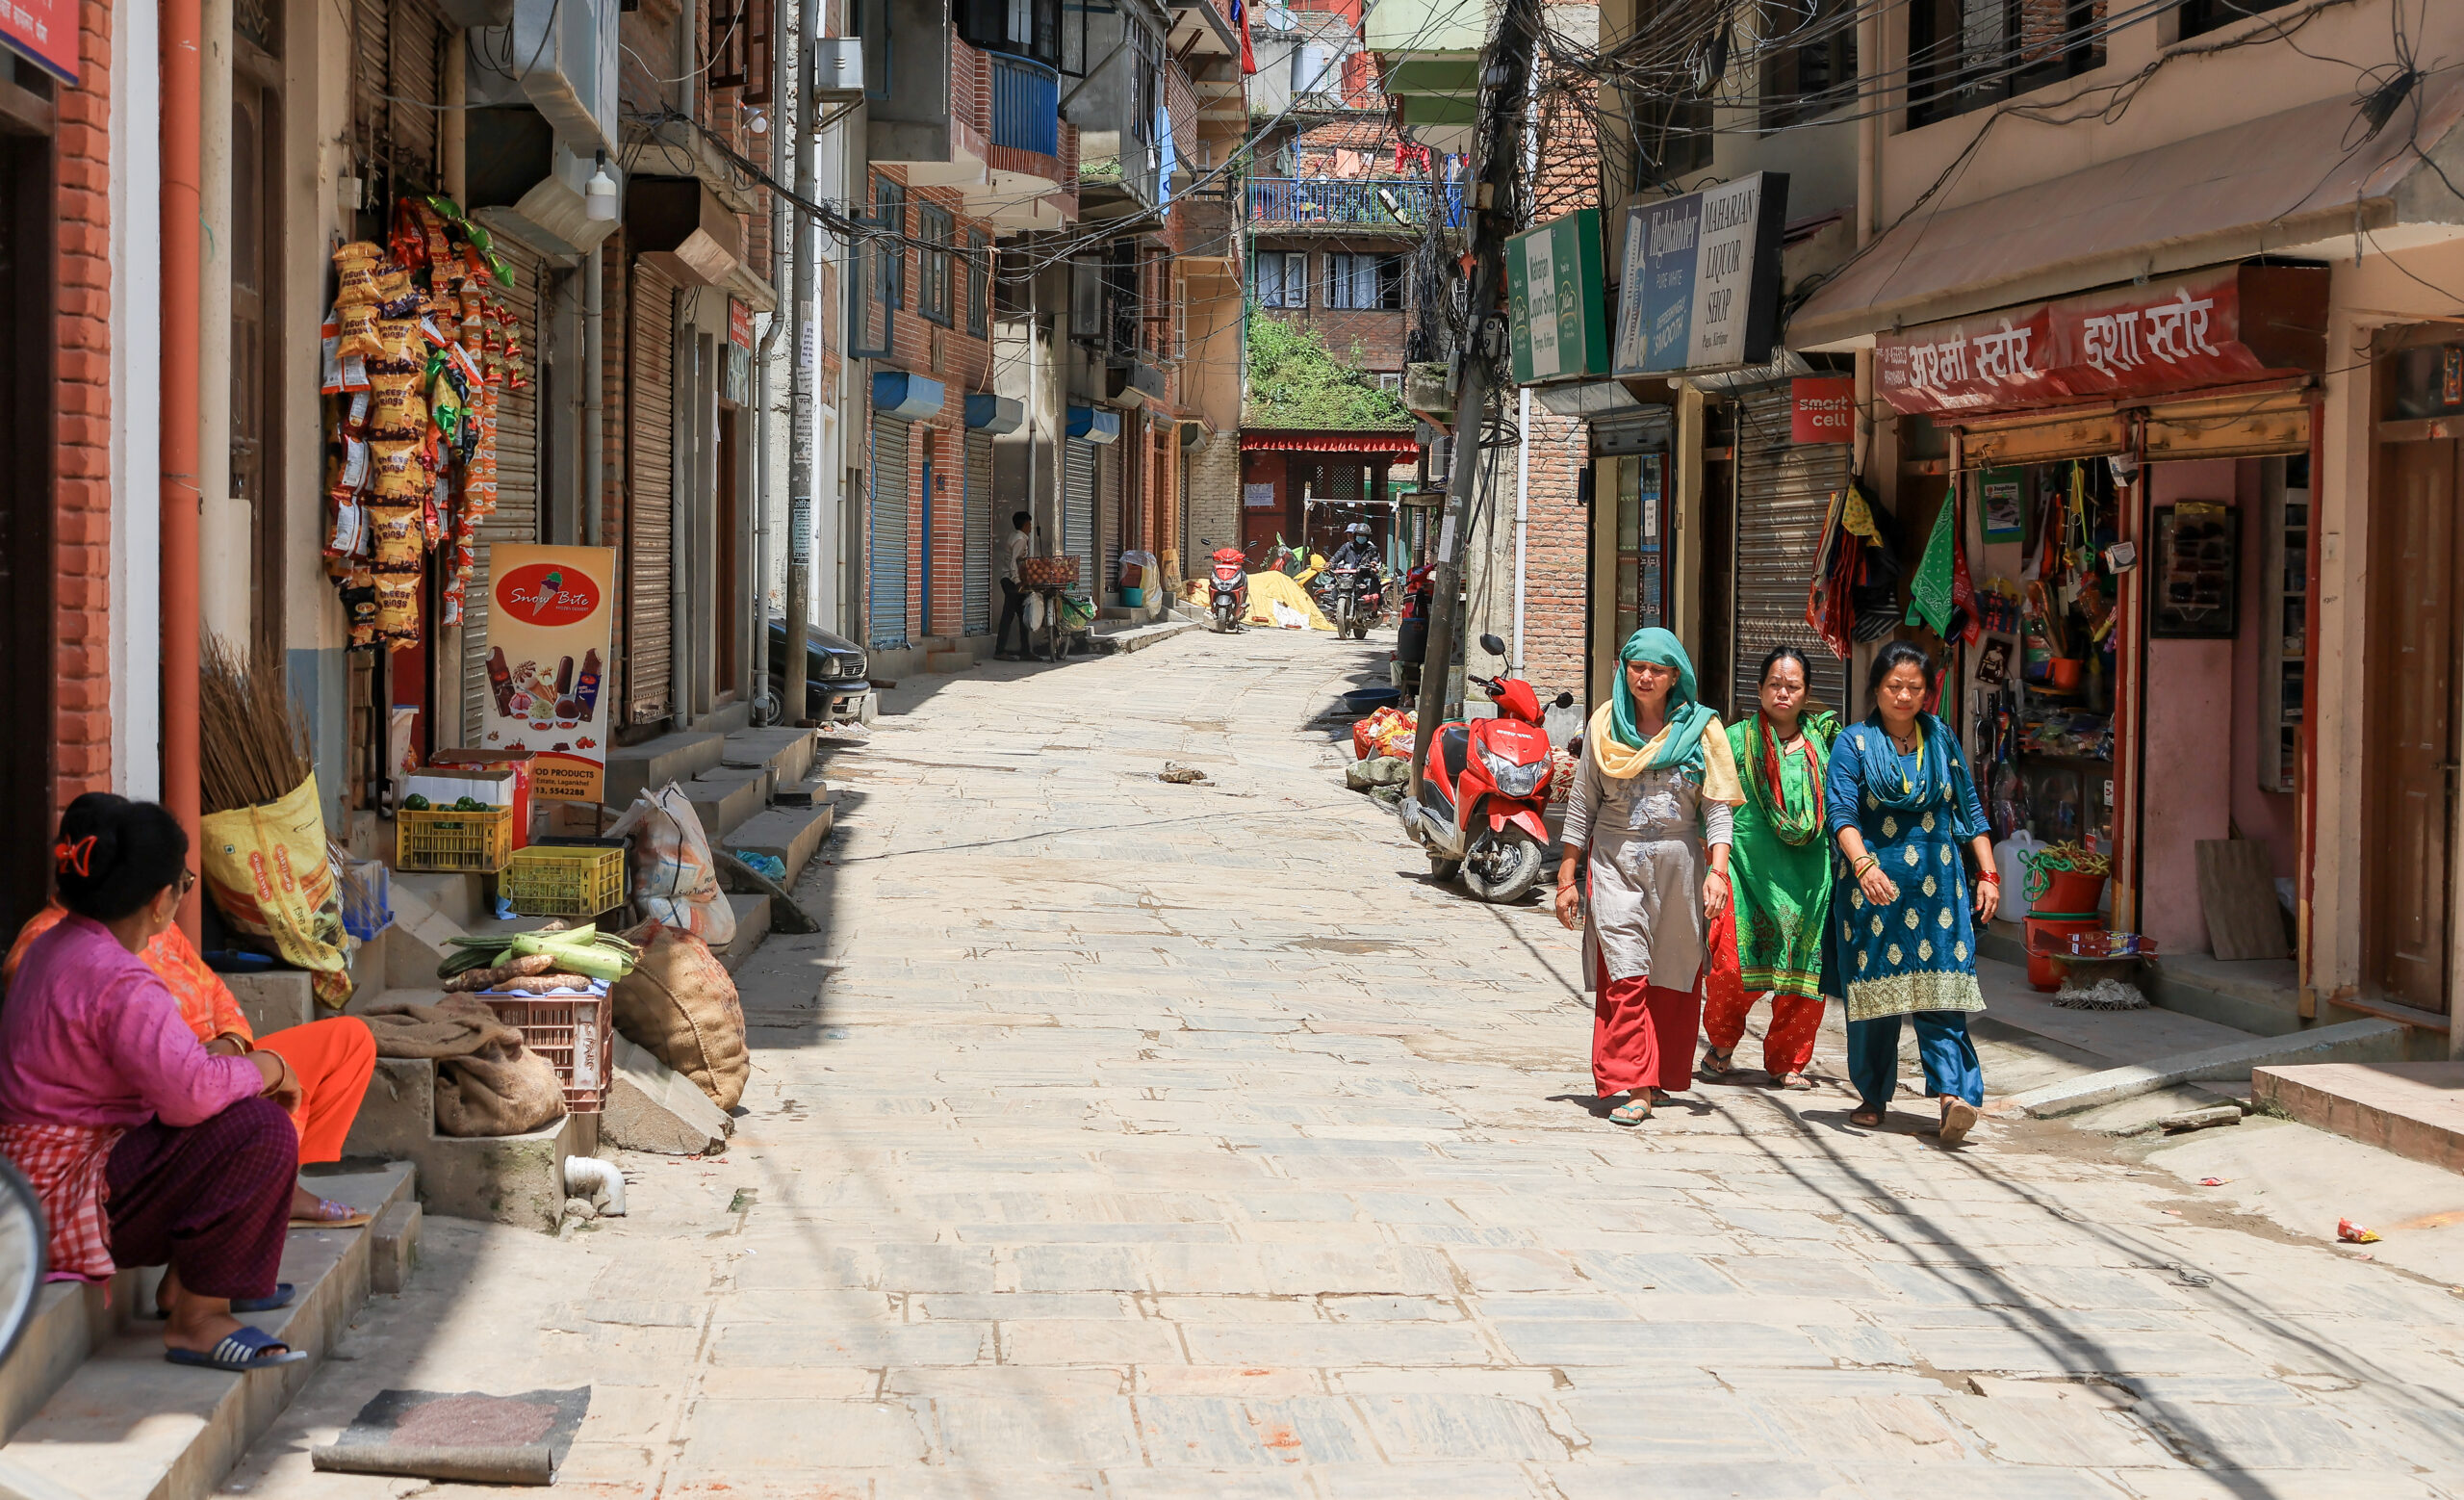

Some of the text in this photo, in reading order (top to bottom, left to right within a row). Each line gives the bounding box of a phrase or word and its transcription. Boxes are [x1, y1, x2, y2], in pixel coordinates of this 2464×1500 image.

[1703, 189, 1756, 235] MAHARJAN
[1649, 204, 1698, 270] Highlander
[1528, 252, 1550, 285] Maharjan
[1706, 240, 1741, 283] LIQUOR
[1528, 294, 1543, 323] Liquor
[1543, 289, 1555, 319] Shop
[1706, 289, 1732, 324] SHOP
[1654, 315, 1684, 356] SMOOTH
[2084, 286, 2220, 377] इशा स्टोर
[1973, 317, 2038, 386] स्टोर
[1799, 396, 1848, 411] smart
[1811, 413, 1847, 427] cell
[510, 587, 590, 606] Snow Bite
[536, 778, 589, 788] Estate, Lagankhel
[551, 768, 595, 779] PRODUCTS
[549, 787, 585, 796] 5542288
